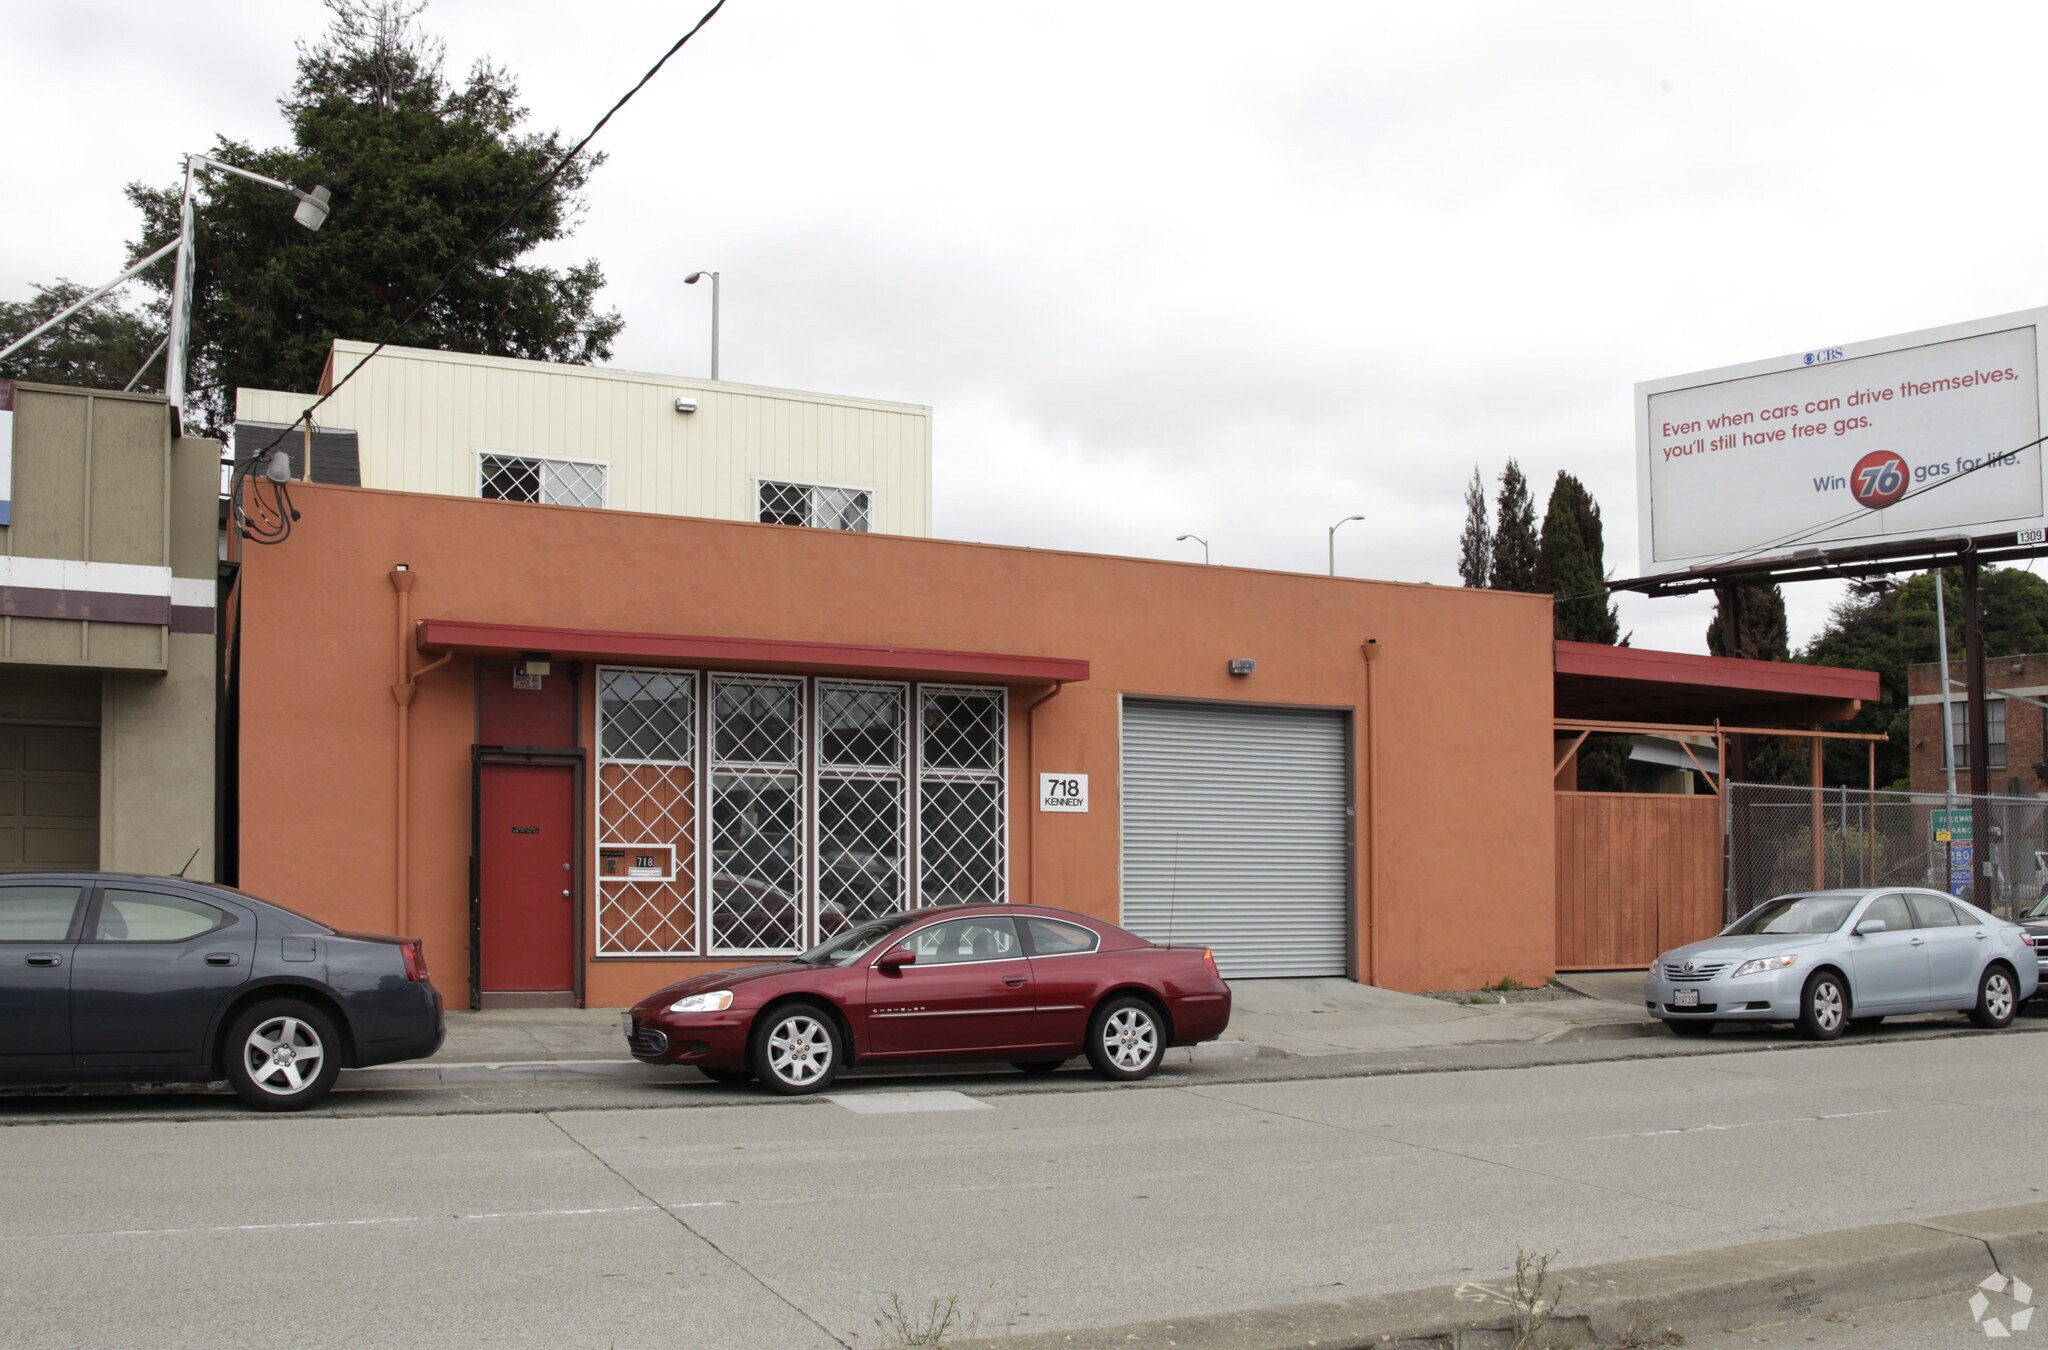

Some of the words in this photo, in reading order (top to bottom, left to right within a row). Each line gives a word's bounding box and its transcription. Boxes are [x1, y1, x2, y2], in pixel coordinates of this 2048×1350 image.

[1816, 347, 1843, 362] CBS
[1662, 421, 1702, 438] Even
[1706, 412, 1755, 430] when
[1760, 404, 1799, 421] cars
[1804, 397, 1841, 414] can
[1847, 388, 1894, 407] drive
[1900, 367, 2019, 398] themselves,
[1663, 438, 1705, 462] you'll
[1710, 433, 1737, 452] still
[1742, 429, 1787, 447] have
[1791, 423, 1828, 439] free
[1833, 415, 1873, 436] gas.
[1813, 475, 1846, 492] Win
[1857, 459, 1901, 498] 76
[1914, 462, 1950, 483] gas
[1955, 456, 1982, 473] for
[1987, 450, 2021, 469] life.
[2020, 530, 2042, 542] 1309
[1048, 779, 1080, 797] 718
[1044, 797, 1084, 807] KENNEDY
[636, 857, 654, 867] 718
